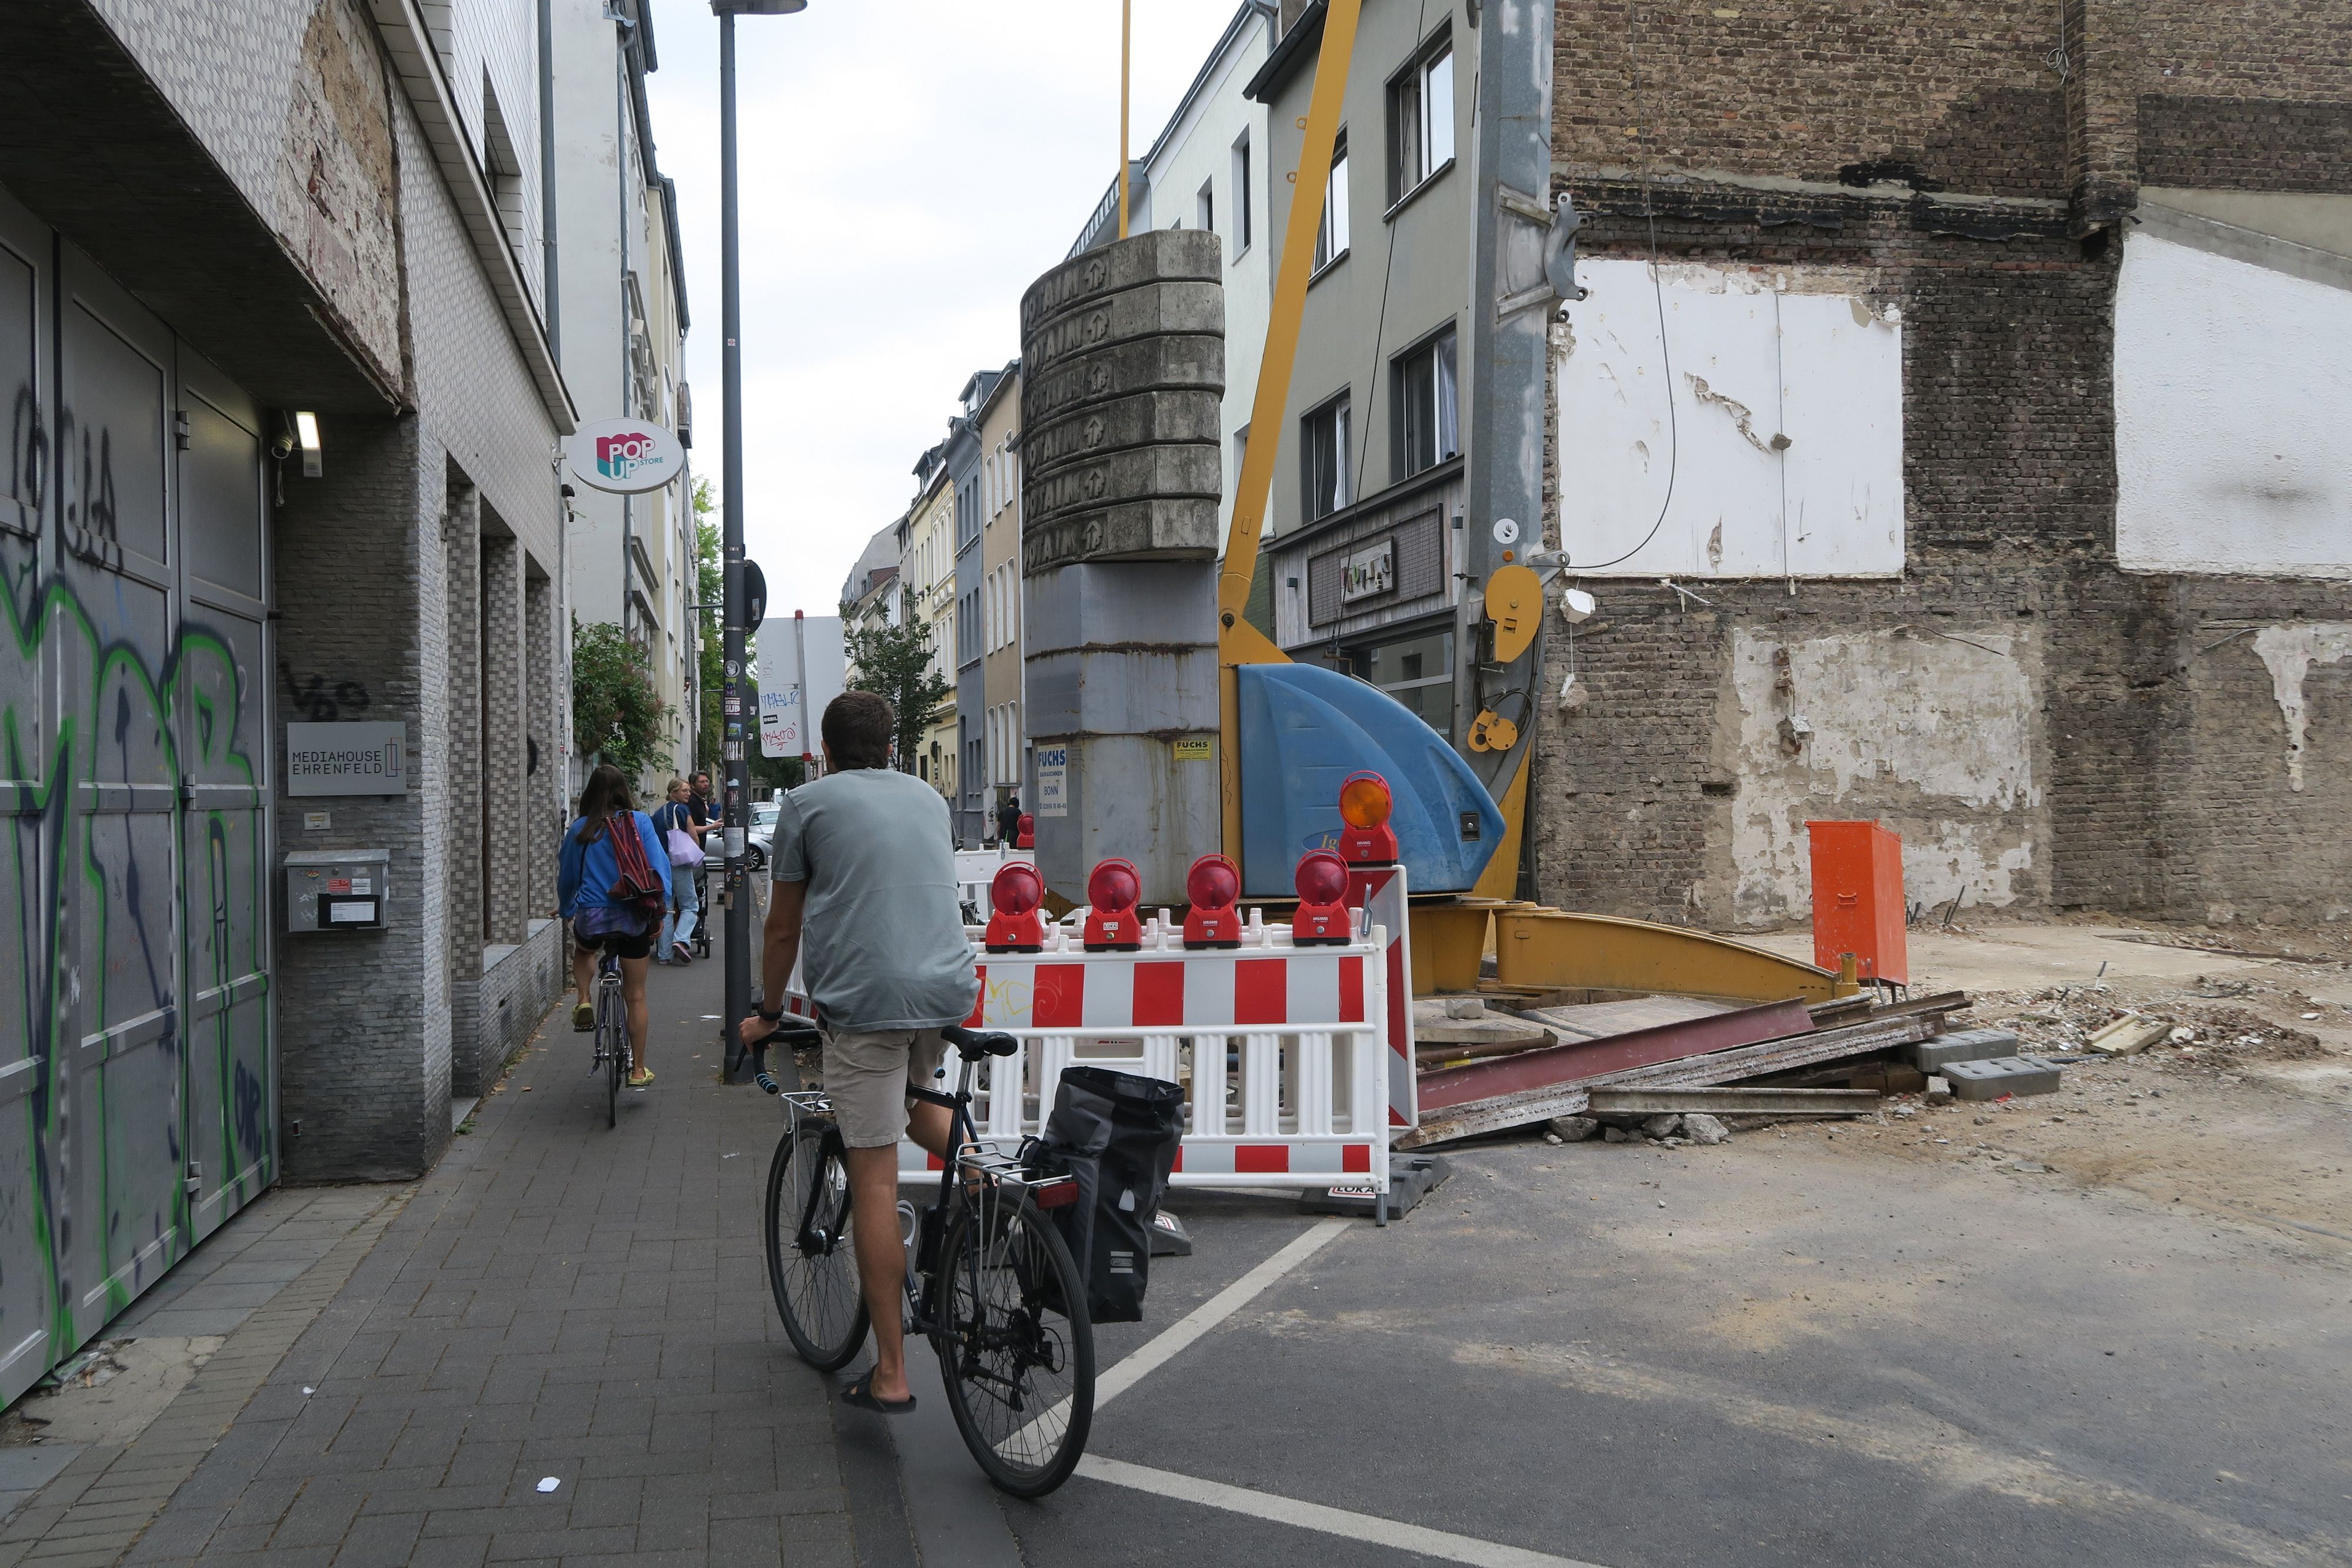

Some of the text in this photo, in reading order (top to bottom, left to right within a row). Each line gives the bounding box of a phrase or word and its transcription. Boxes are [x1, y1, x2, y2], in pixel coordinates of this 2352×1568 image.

[609, 439, 655, 463] POP
[610, 457, 663, 480] UP STORE
[1024, 472, 1081, 523] POTAIN
[293, 751, 381, 763] MEDIAHOUSE
[1038, 750, 1065, 767] FUCHS
[293, 763, 382, 775] EHRENFELD
[1044, 786, 1058, 795] BONN
[1321, 834, 1339, 851] Ig
